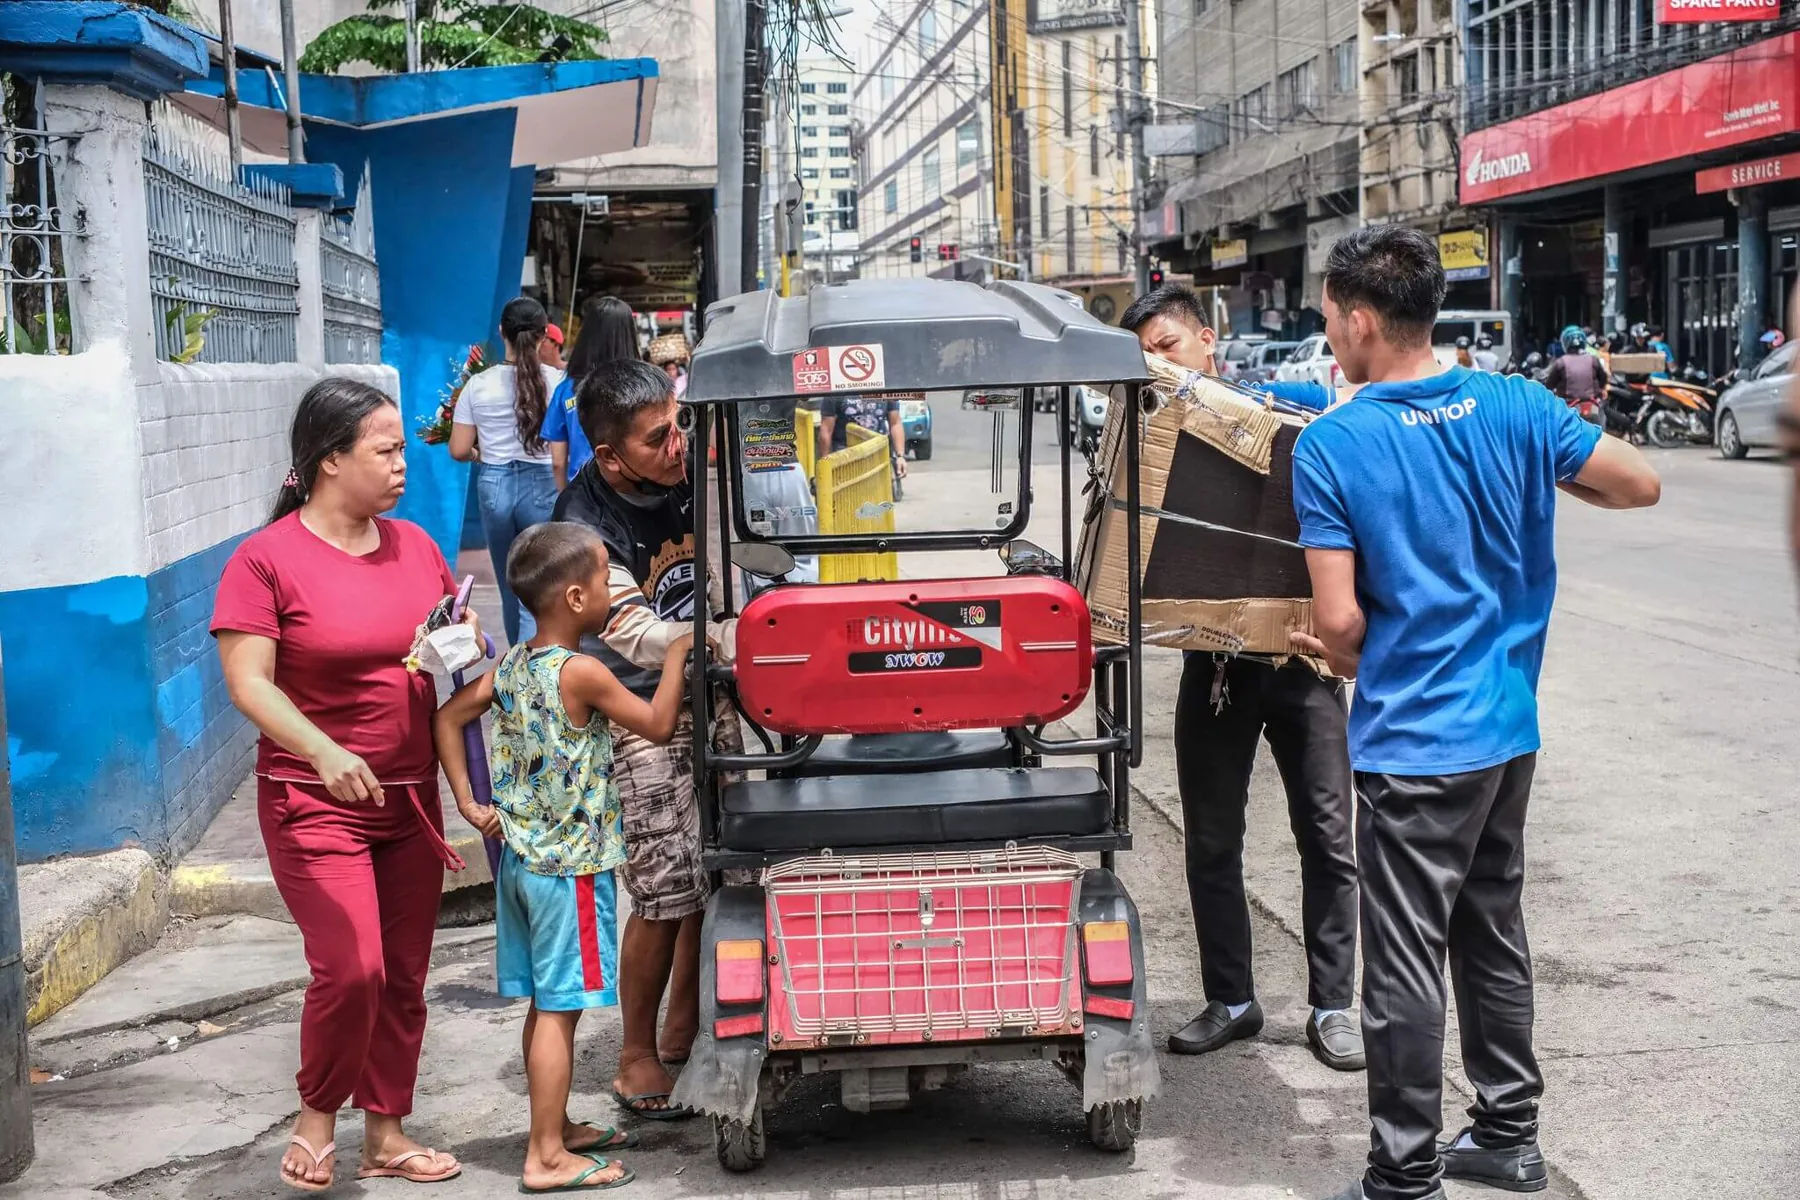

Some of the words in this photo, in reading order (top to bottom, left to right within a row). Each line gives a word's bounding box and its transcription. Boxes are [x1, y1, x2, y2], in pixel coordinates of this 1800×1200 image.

[1480, 152, 1532, 183] HONDA
[1731, 160, 1781, 184] SERVICE
[1400, 397, 1477, 426] UNITOP
[885, 651, 945, 668] NWOW
